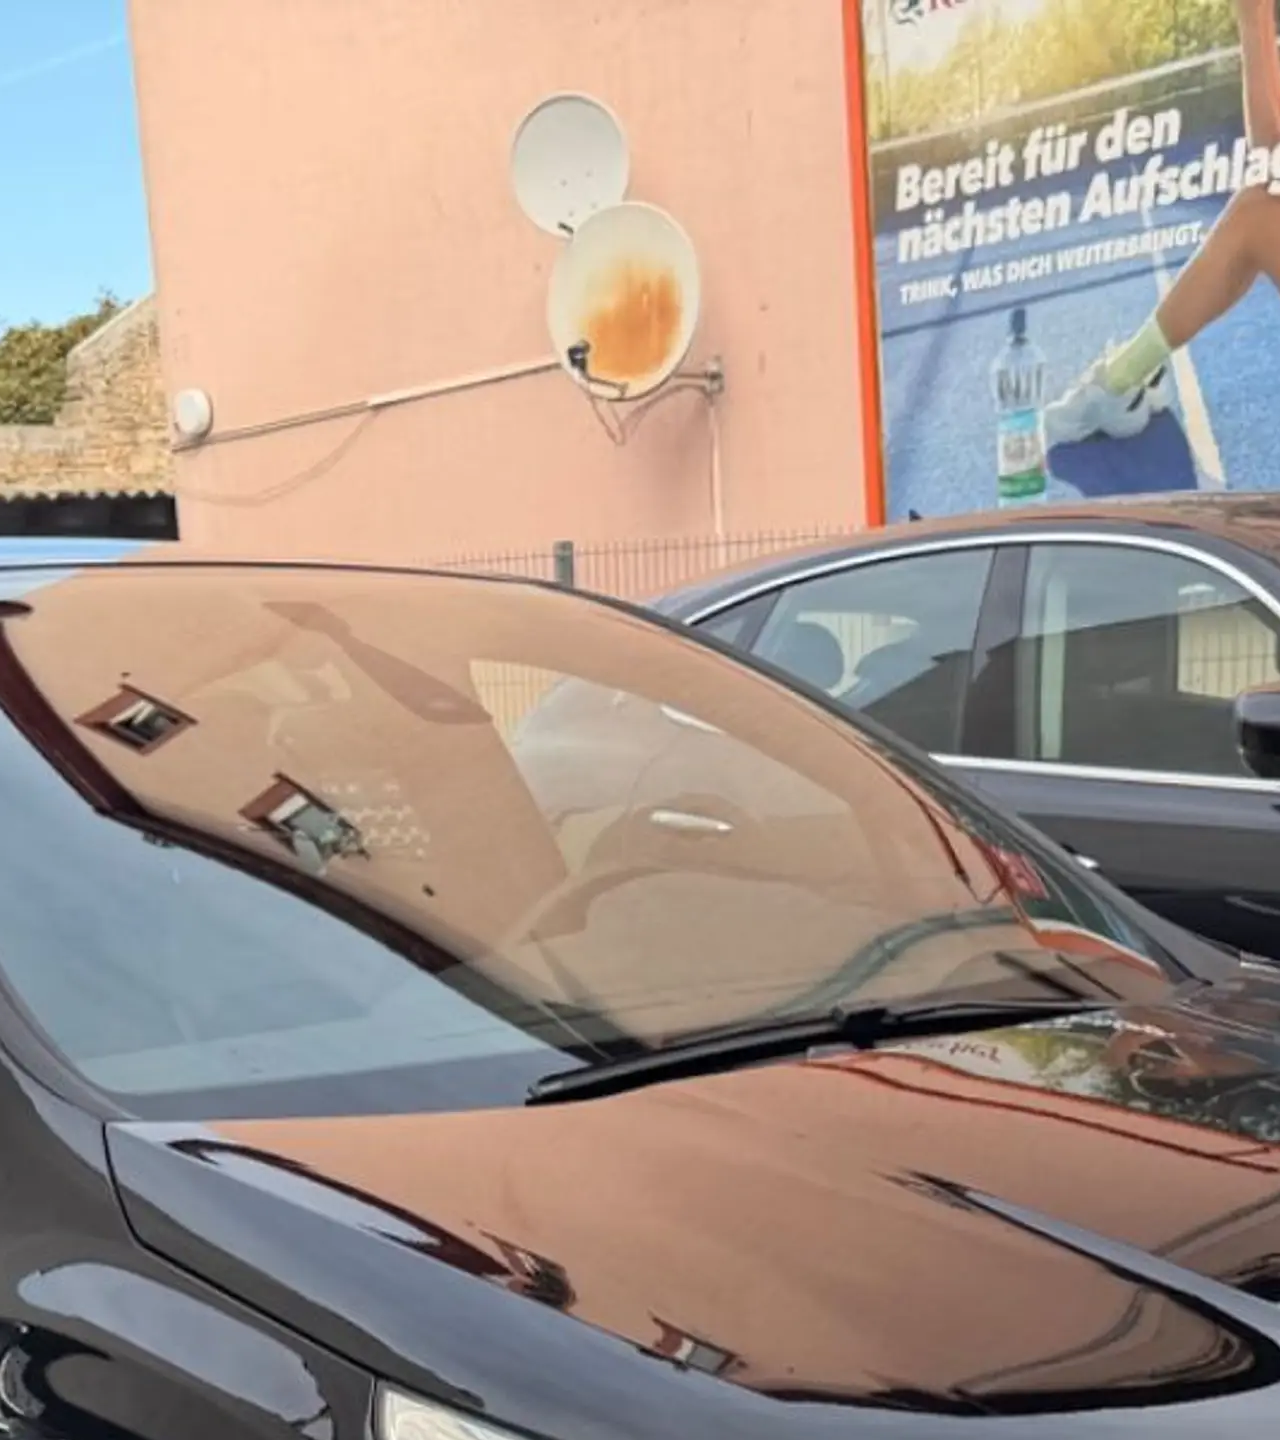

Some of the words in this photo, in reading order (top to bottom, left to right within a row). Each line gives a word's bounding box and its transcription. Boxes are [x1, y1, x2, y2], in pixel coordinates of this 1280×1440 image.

[895, 138, 1016, 212] Bereit
[1023, 122, 1088, 182] für
[1094, 108, 1182, 163] den
[897, 190, 1072, 264] nächsten
[900, 273, 958, 305] TRINK,
[961, 264, 1006, 293] WAS
[1006, 253, 1054, 284] DICH
[1056, 220, 1206, 273] WEITERBRINGT.
